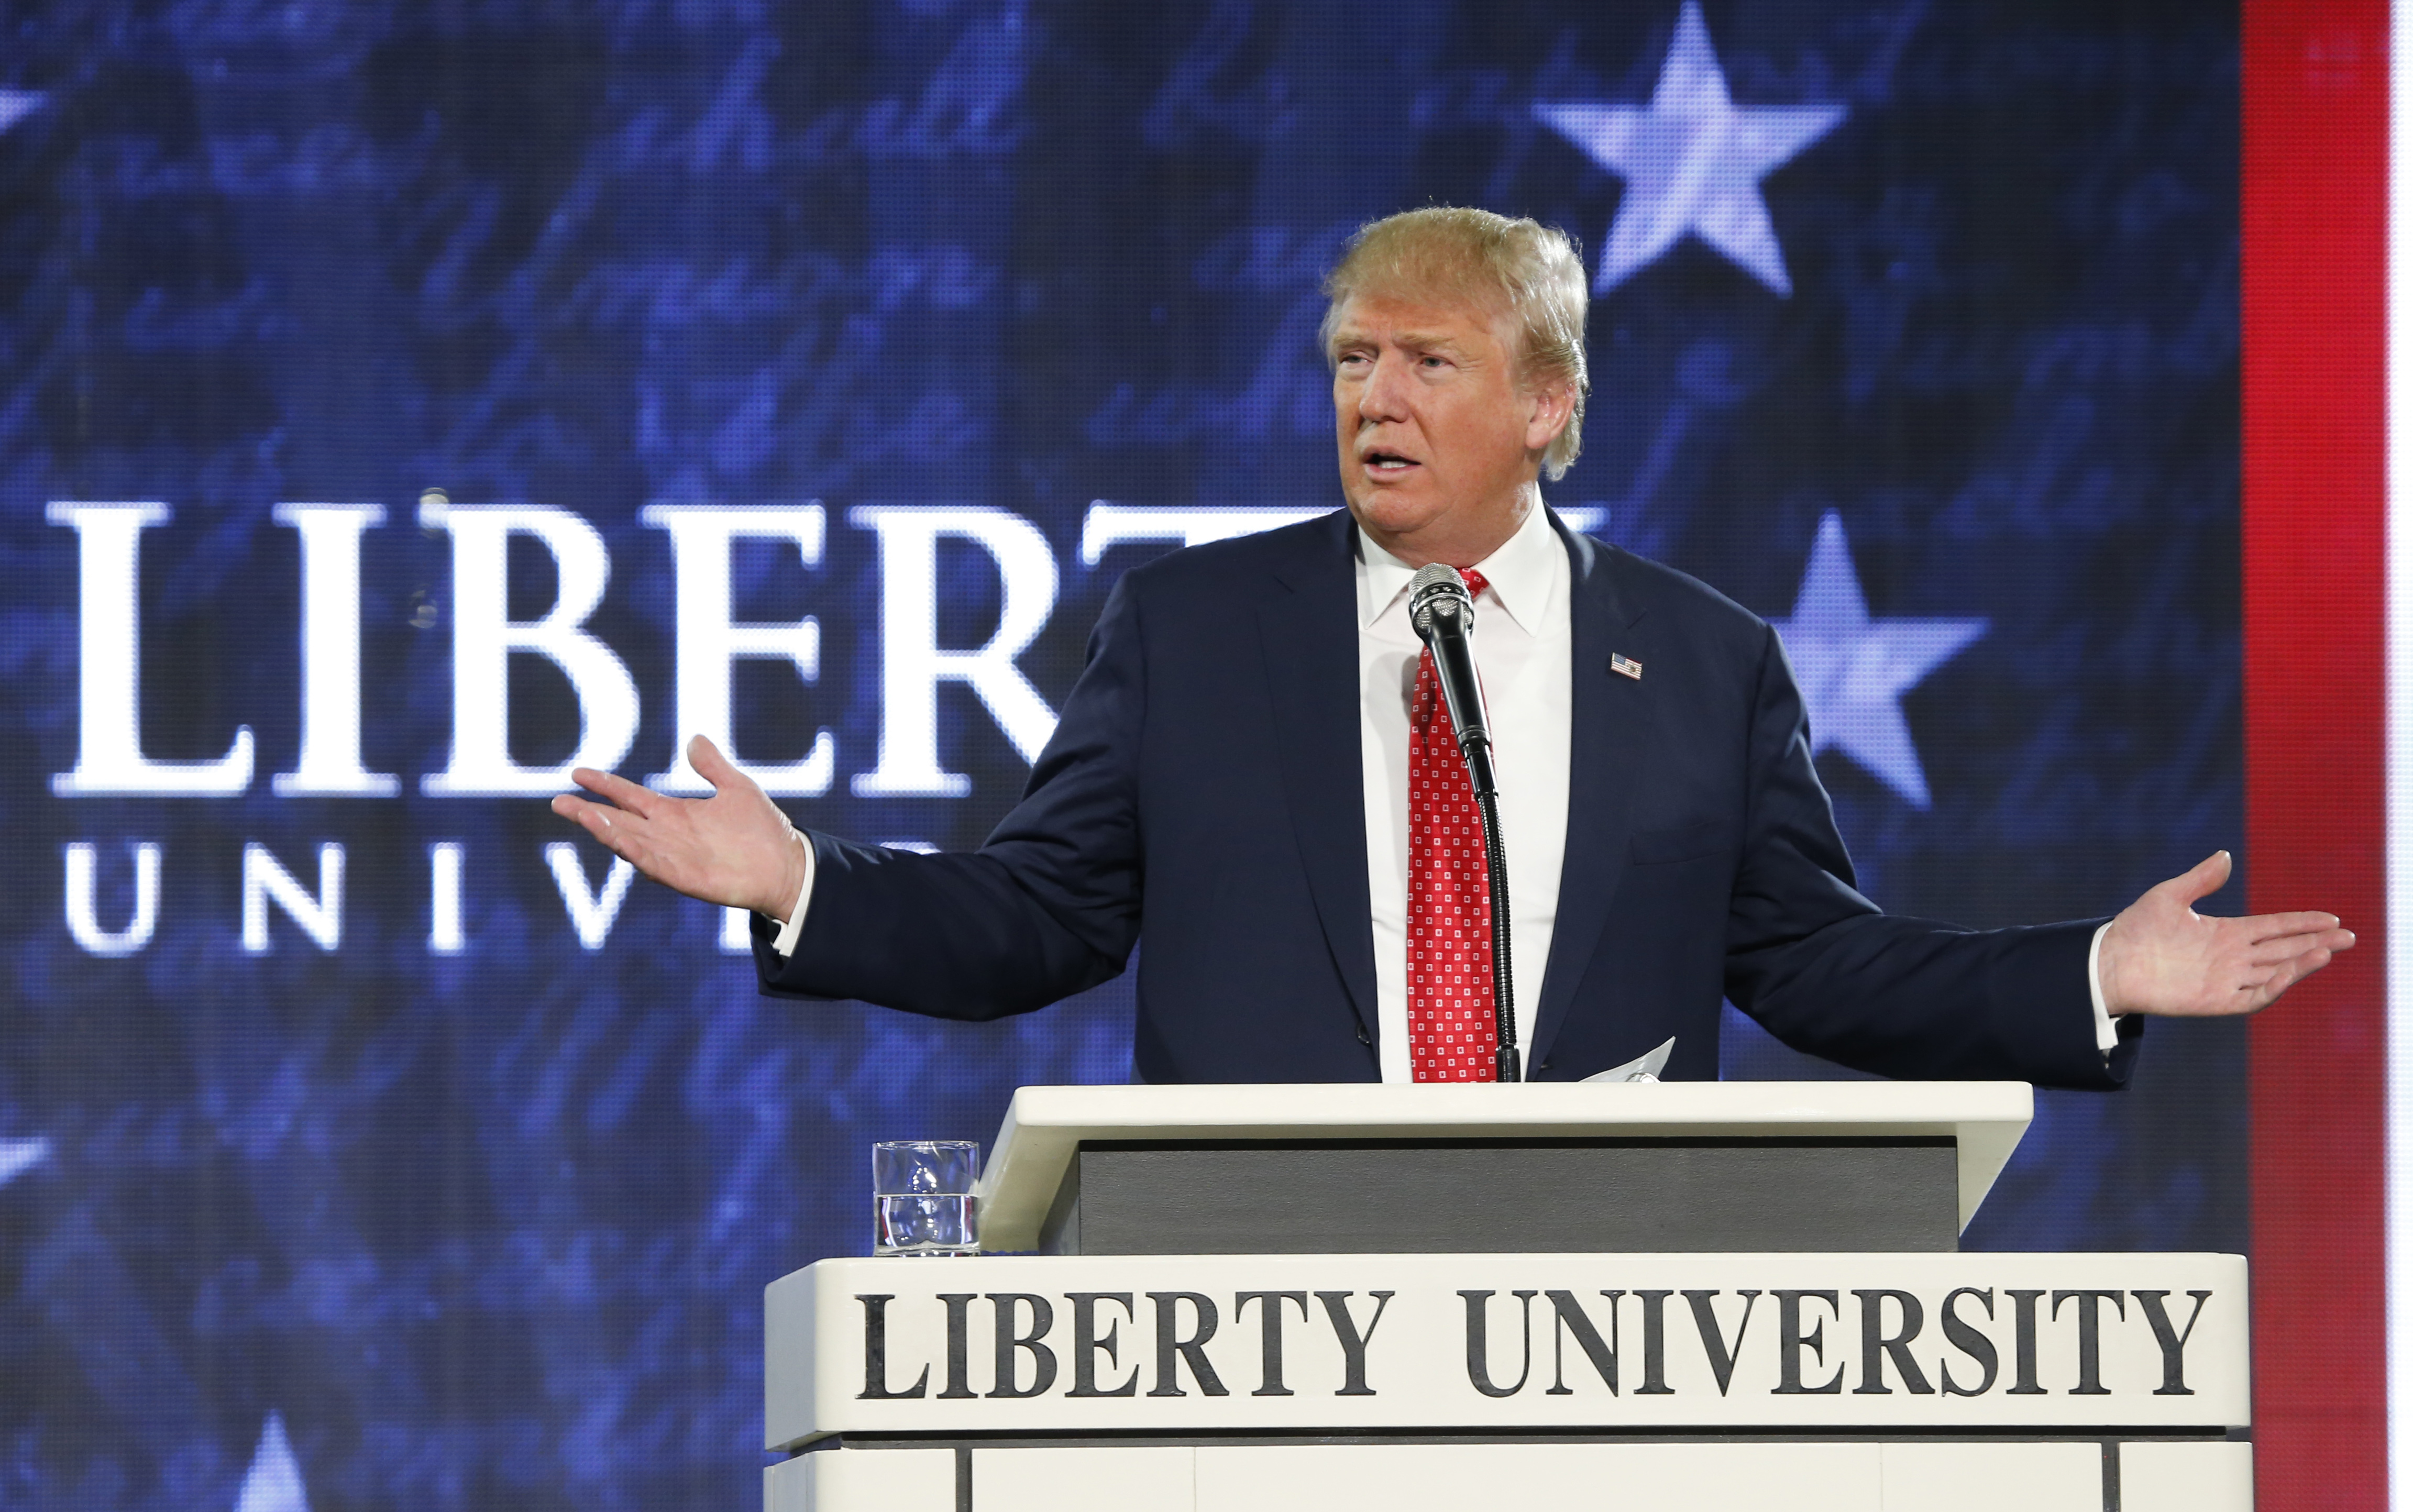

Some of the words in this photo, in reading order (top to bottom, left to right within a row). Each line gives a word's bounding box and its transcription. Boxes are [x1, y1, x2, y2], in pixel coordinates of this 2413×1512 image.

[46, 500, 1609, 798] LIBER
[854, 1290, 1395, 1399] LIBERTY
[1456, 1287, 2213, 1398] UNIVERSITY
